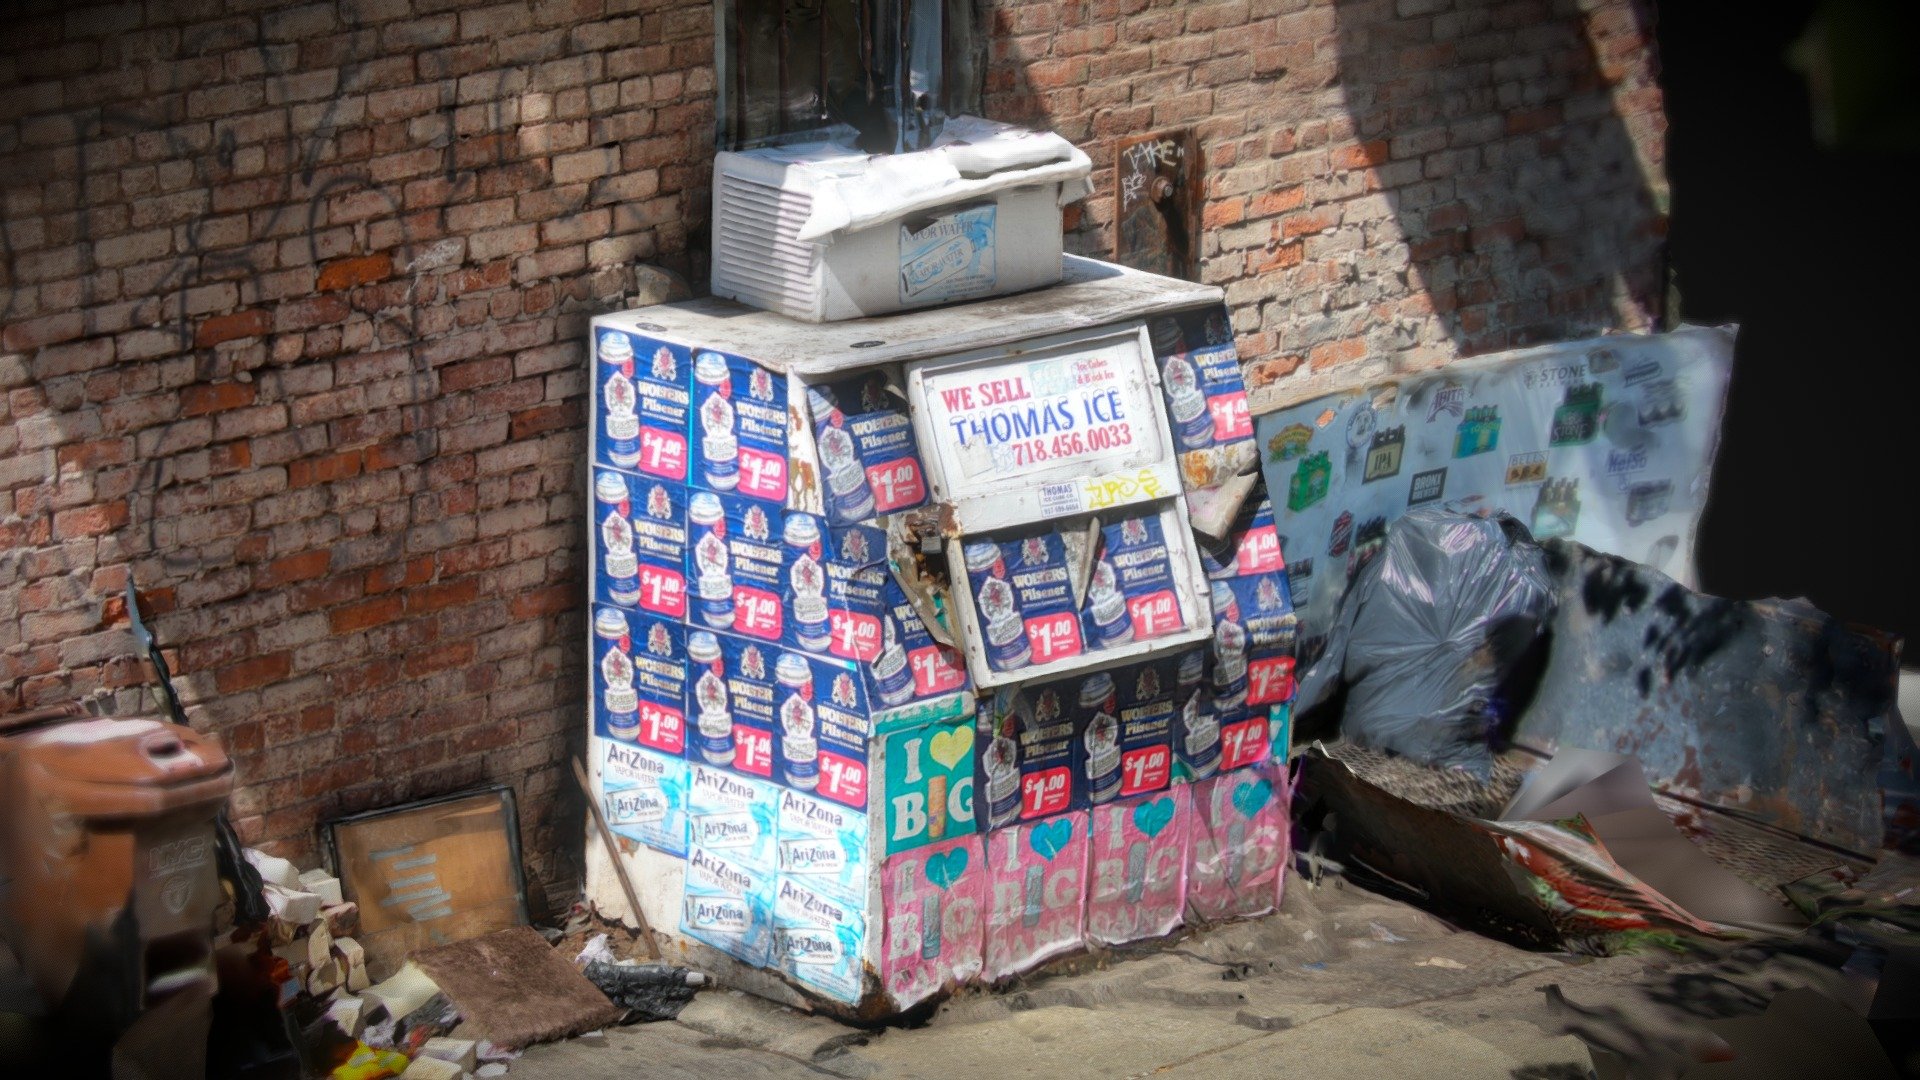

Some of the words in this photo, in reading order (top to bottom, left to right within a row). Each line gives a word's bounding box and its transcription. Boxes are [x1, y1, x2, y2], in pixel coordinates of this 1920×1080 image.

[903, 226, 937, 241] VPOR
[1084, 372, 1103, 383] Bock
[1540, 364, 1586, 381] STONE
[638, 381, 689, 404] WOLTERS
[941, 386, 975, 414] WE
[978, 376, 1031, 407] SELL
[643, 398, 685, 418] Pilsener
[736, 401, 786, 424] WOLTERS
[950, 395, 1075, 445] THOMAS
[1081, 385, 1125, 425] ICE
[742, 418, 782, 437] Pilsener
[643, 431, 681, 468] $1.00
[860, 430, 907, 449] Pilsener
[1012, 423, 1132, 466] 718.456.0033
[742, 456, 781, 489] $1.00
[1374, 452, 1391, 471] IPA
[871, 465, 913, 503] $1.00
[1042, 484, 1073, 496] THOMAS
[634, 520, 685, 542] WOLTERS
[639, 536, 681, 555] Pilsener
[730, 540, 782, 563] WOLTERS
[735, 557, 779, 575] Pilsener
[1012, 567, 1067, 587] WOLTERS
[1123, 562, 1165, 581] Pilsener
[642, 571, 679, 605] $1.00
[831, 581, 878, 597] Pilsener
[1021, 585, 1066, 601] Pilsener
[737, 592, 776, 628] $1.00
[1132, 598, 1171, 634] $1.00
[832, 615, 875, 650] $1.00
[1030, 620, 1071, 656] $1.00
[635, 656, 686, 680] WOLTERS
[639, 672, 681, 692] Pilsener
[728, 678, 773, 700] WOLTER
[817, 704, 868, 735] WOLTERS
[1121, 701, 1173, 722] WOLTERS
[642, 708, 678, 741] $1.00
[822, 721, 863, 746] Pilsener
[1126, 719, 1169, 736] Pilsener
[607, 743, 664, 774] AriZona
[903, 737, 923, 784] I
[1024, 741, 1070, 757] Pilsener
[822, 756, 862, 793] $1.00
[1125, 752, 1164, 787] $1.00
[694, 768, 755, 800] AriZona
[1025, 774, 1065, 811] $1.00
[618, 797, 659, 815] AriZona
[782, 791, 843, 826] AriZona
[704, 822, 747, 838] AriZona
[1109, 806, 1126, 850] I
[792, 848, 836, 863] AriZona
[1001, 828, 1021, 872] I
[691, 848, 751, 888] AriZona
[897, 859, 918, 904] I
[697, 903, 744, 920] AriZona
[779, 880, 843, 922] AriZona
[787, 936, 832, 952] AriZona
